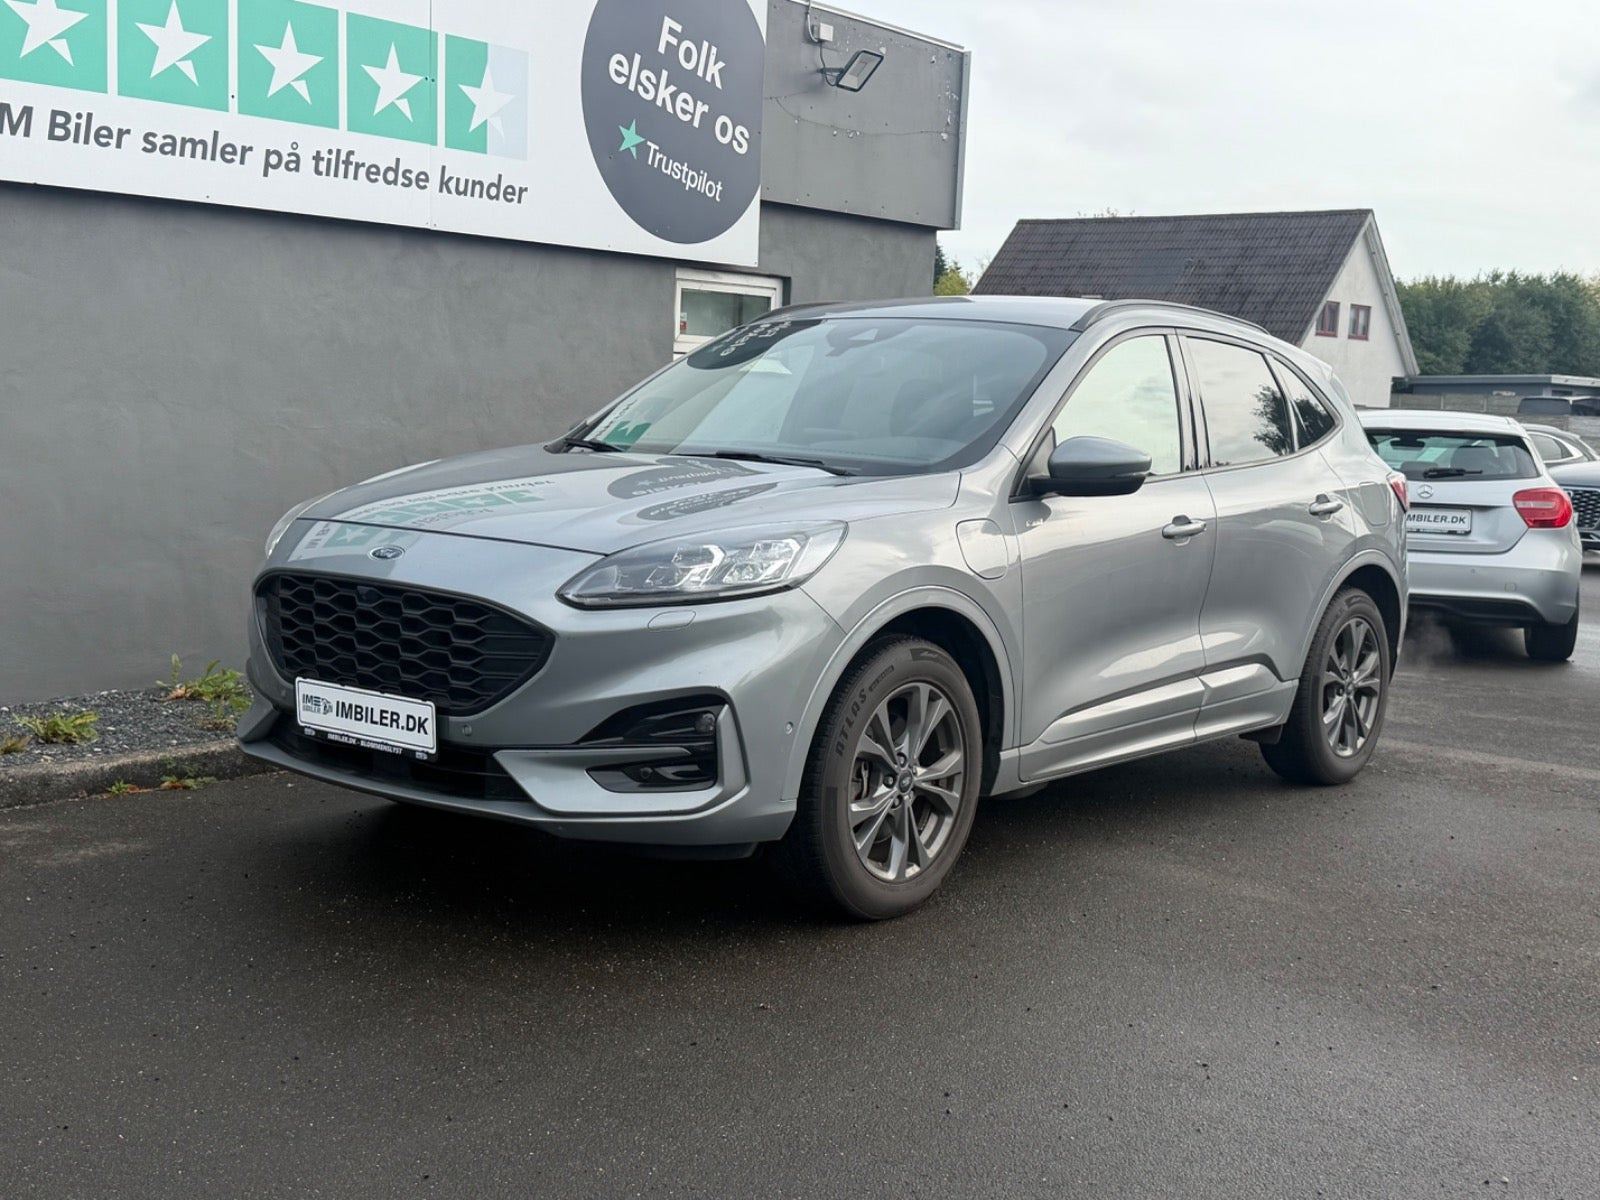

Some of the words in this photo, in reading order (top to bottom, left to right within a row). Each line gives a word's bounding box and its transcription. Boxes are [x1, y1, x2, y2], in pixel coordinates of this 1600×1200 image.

[658, 16, 726, 90] Folk
[608, 52, 709, 129] elsker
[715, 115, 750, 155] os
[48, 109, 131, 149] Biler
[141, 130, 253, 166] samler
[262, 141, 301, 177] på
[312, 148, 430, 190] tilfredse
[438, 165, 528, 204] kunder
[646, 141, 723, 201] Trustpilot
[335, 700, 429, 735] IMBILER.DK
